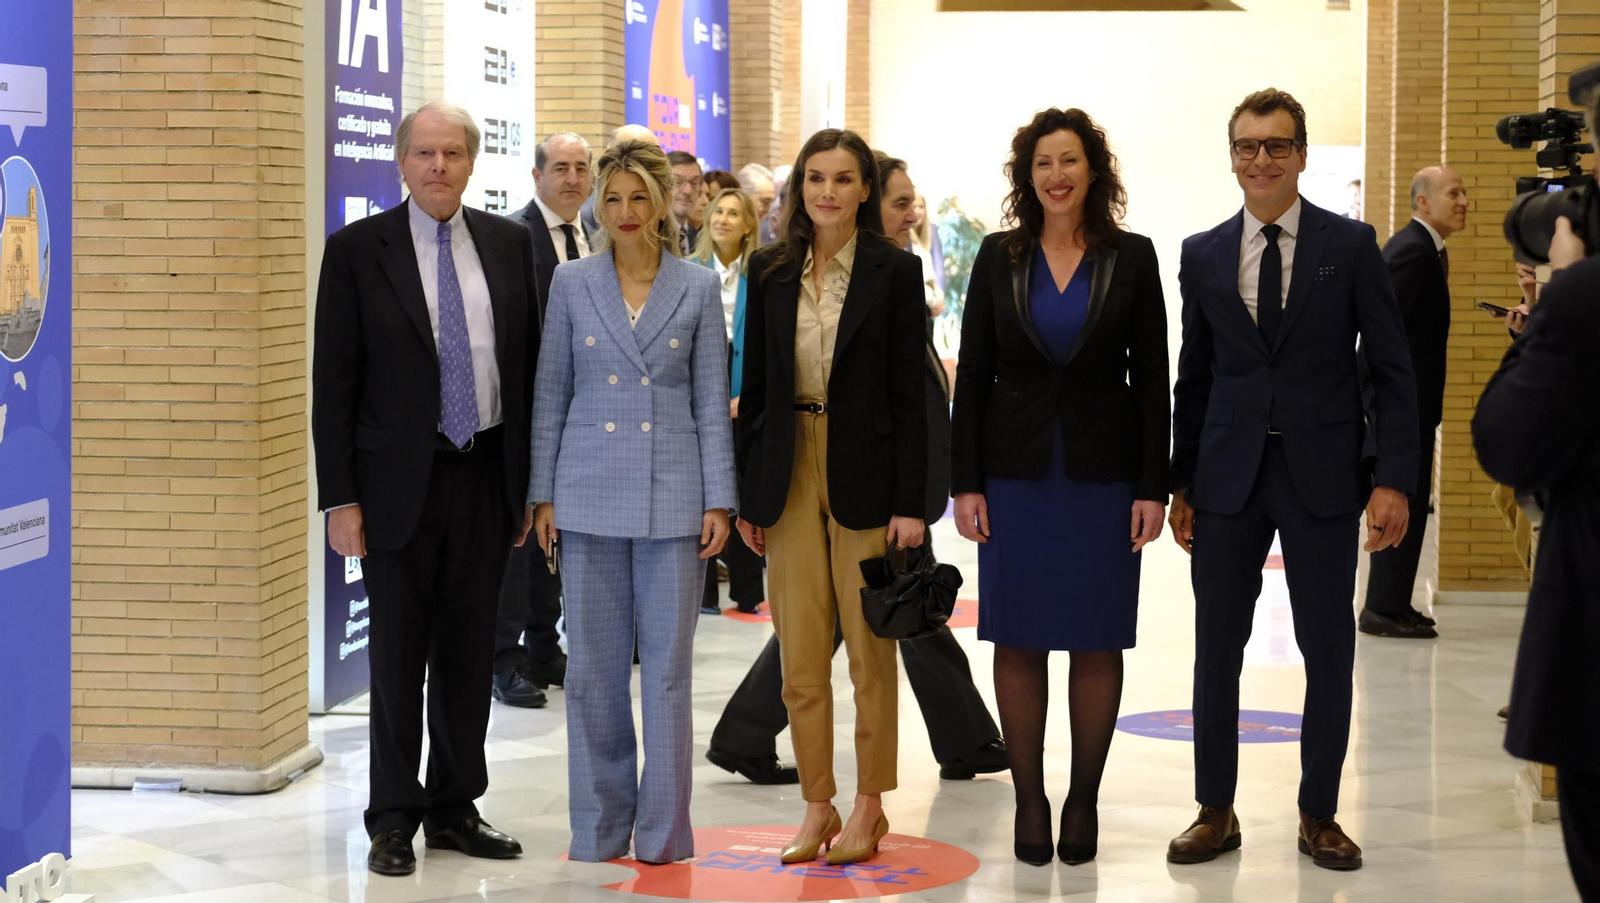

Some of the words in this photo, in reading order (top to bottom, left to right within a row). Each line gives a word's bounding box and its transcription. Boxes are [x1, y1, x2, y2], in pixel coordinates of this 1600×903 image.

[337, 0, 390, 74] IA
[334, 85, 364, 107] Formación
[342, 140, 373, 163] Inteligencia
[19, 515, 46, 531] Valenciana
[697, 859, 910, 885] TOUR
